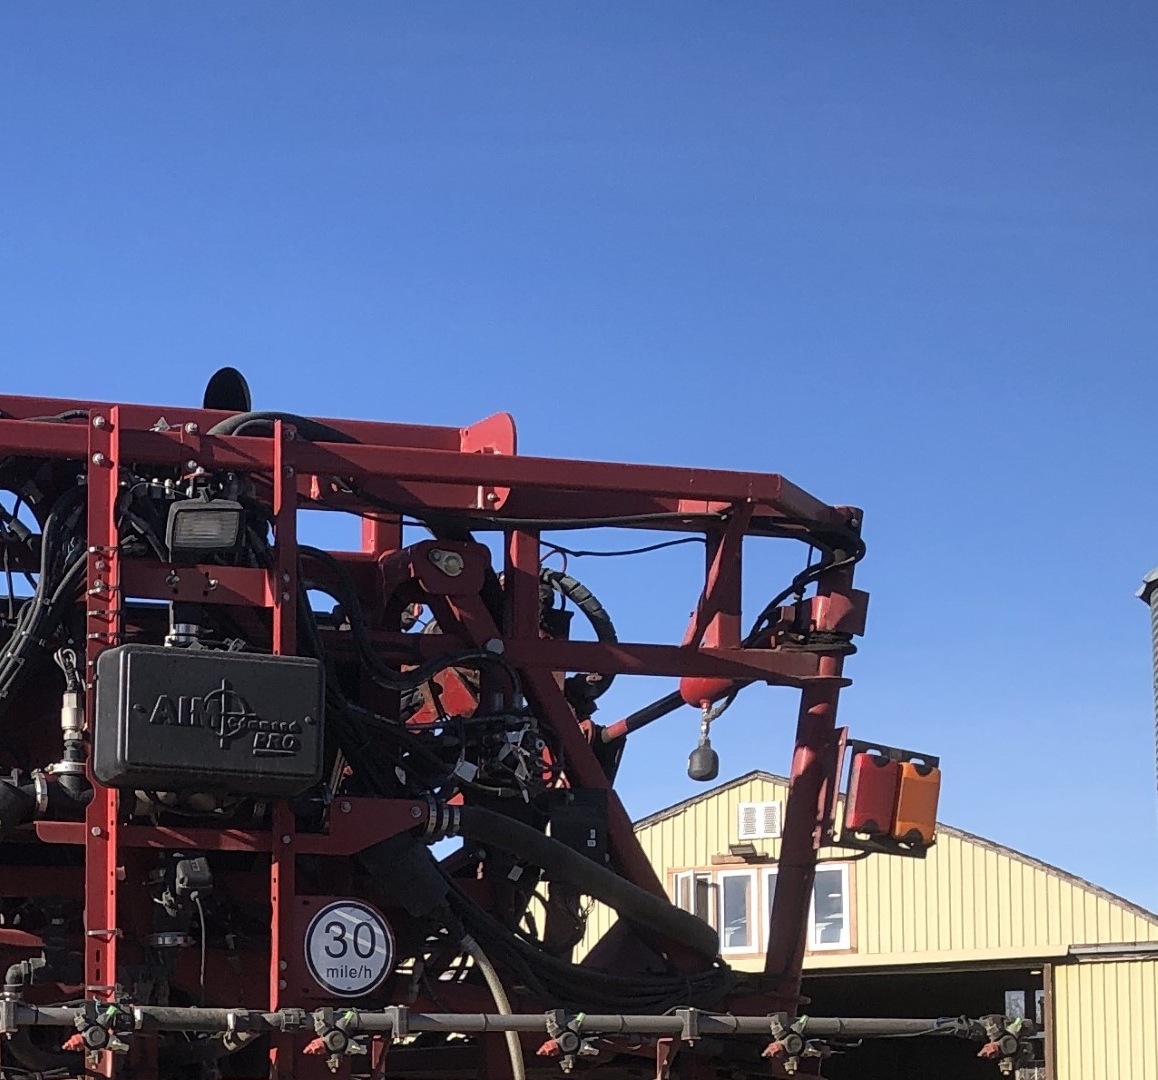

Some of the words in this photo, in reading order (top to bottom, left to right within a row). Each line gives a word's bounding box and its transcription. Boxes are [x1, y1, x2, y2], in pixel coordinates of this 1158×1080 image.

[149, 693, 219, 726] AIM
[252, 731, 299, 749] PRO
[324, 921, 376, 959] 30
[326, 965, 372, 979] mile/h
